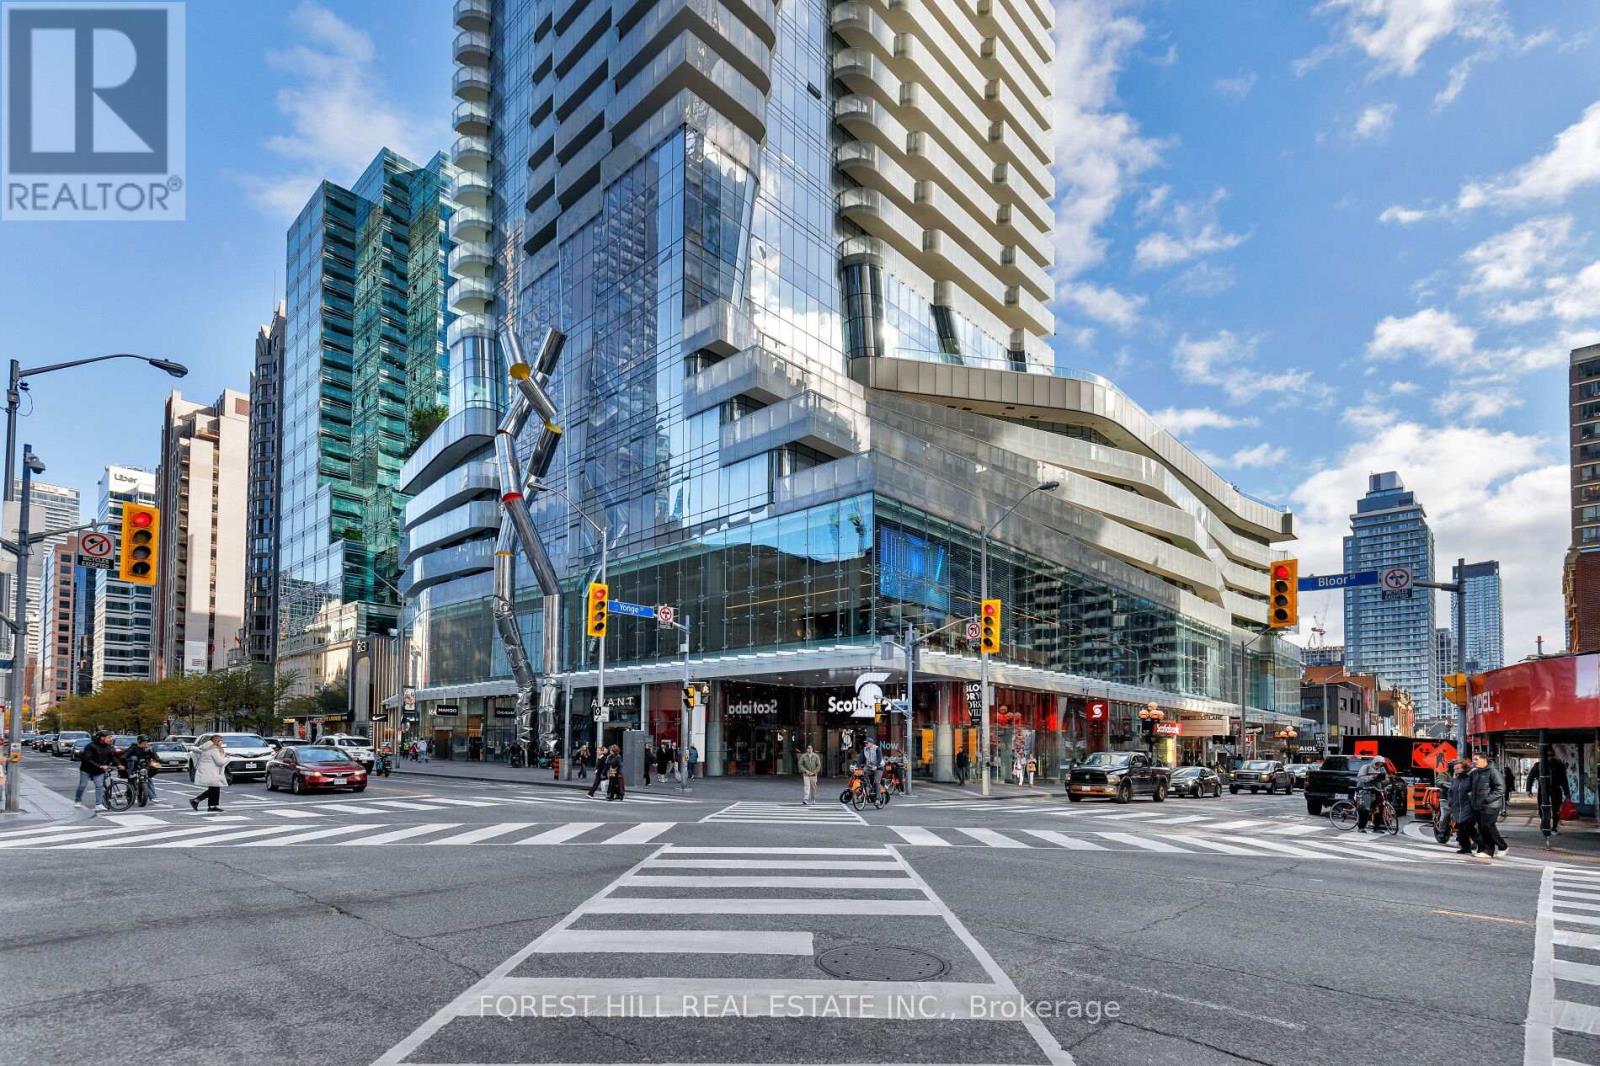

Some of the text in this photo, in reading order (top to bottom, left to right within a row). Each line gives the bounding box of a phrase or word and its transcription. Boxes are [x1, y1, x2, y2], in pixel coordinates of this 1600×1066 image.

[114, 473, 138, 483] Uber
[1318, 577, 1349, 587] Bloor
[620, 603, 640, 613] Yonge
[880, 740, 898, 750] Now
